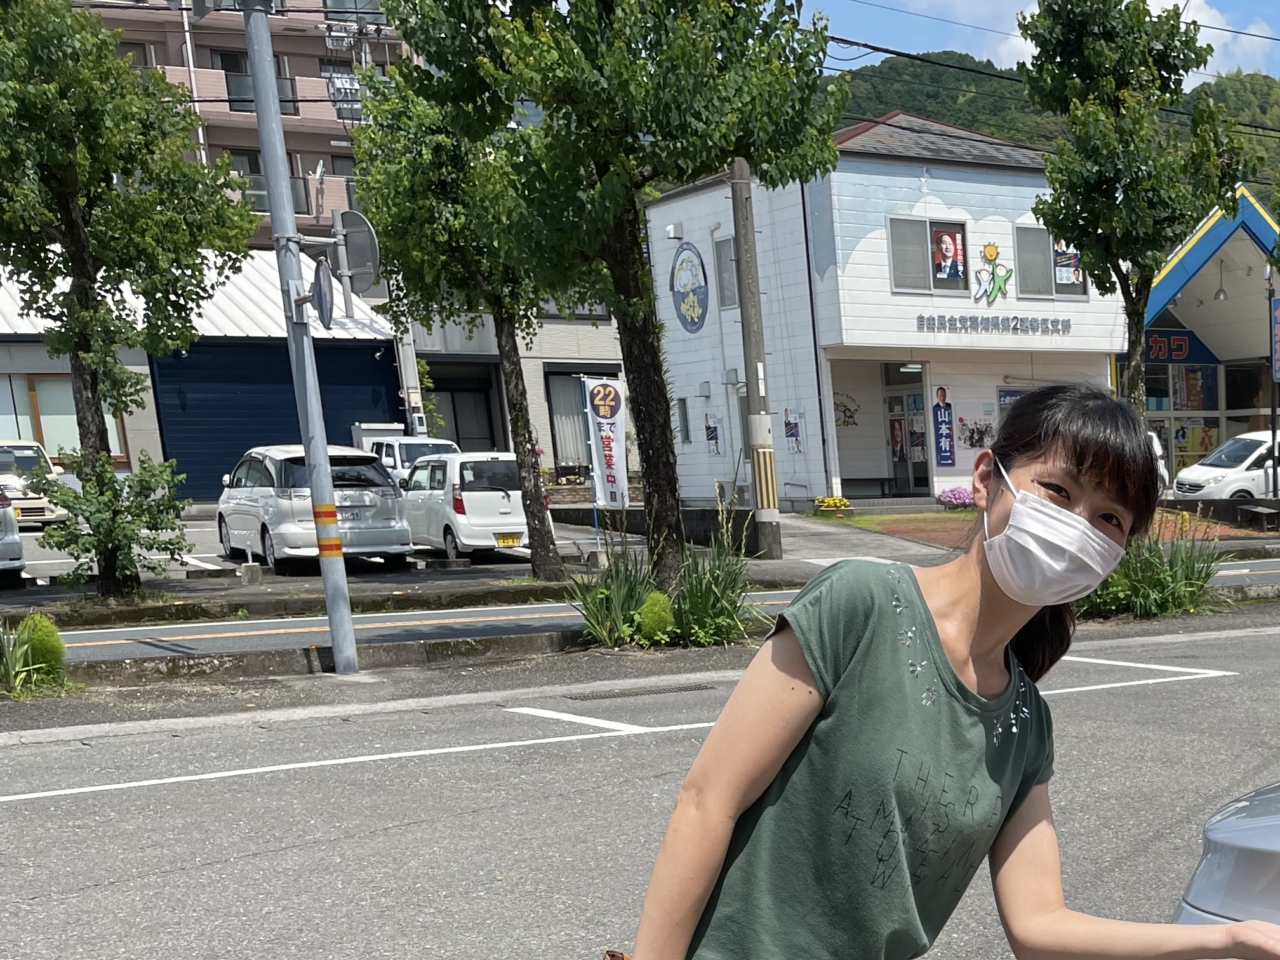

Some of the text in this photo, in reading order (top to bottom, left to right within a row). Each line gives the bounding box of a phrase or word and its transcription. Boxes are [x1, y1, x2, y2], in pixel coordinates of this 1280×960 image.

[1149, 335, 1189, 360] カワ
[593, 385, 616, 406] 22
[599, 405, 611, 418] 時
[596, 421, 616, 434] まで
[937, 408, 953, 464] 山本有二
[600, 435, 617, 489] 営業中
[893, 748, 1003, 828] THERE
